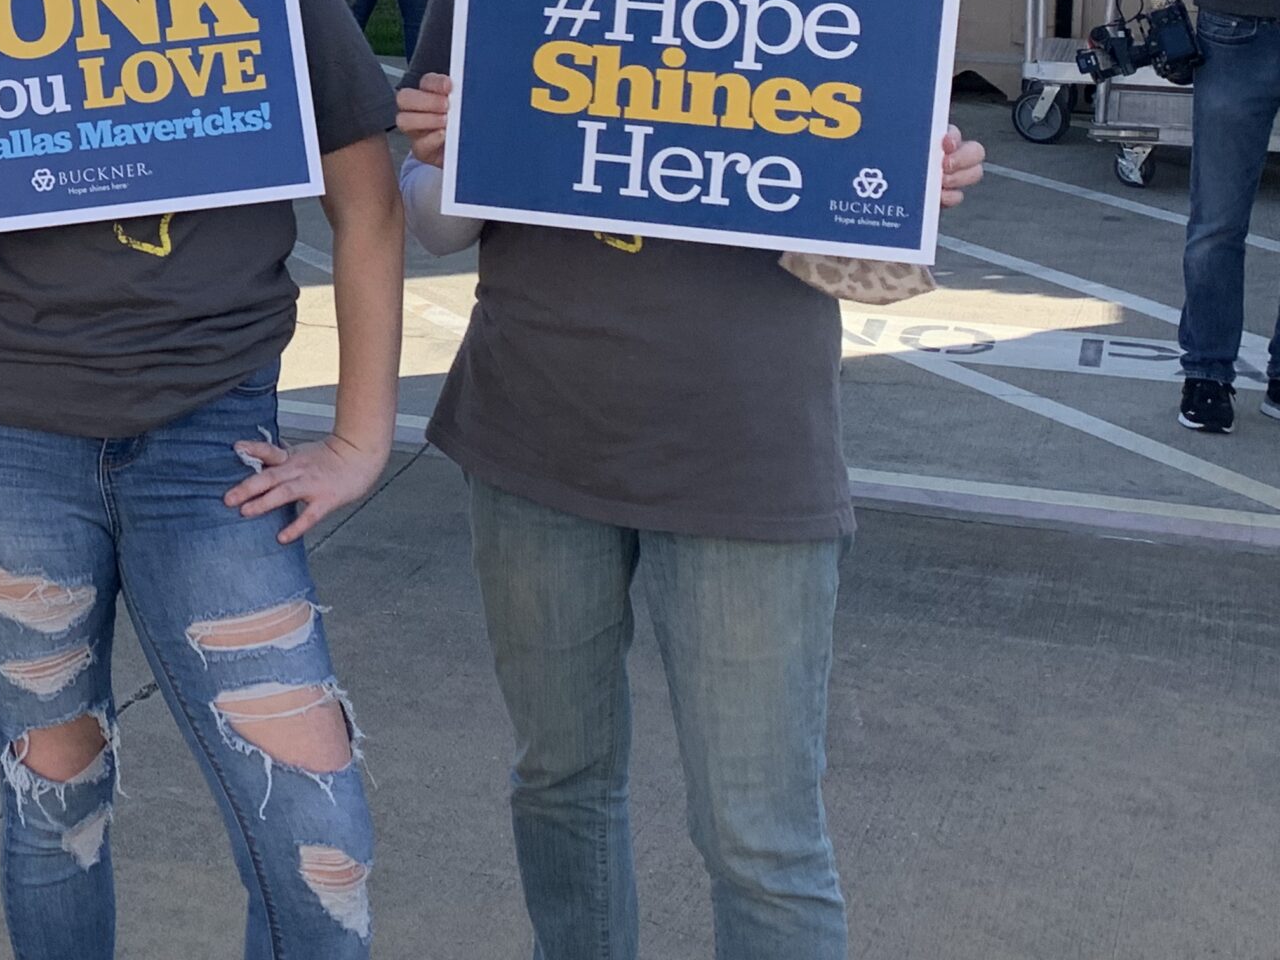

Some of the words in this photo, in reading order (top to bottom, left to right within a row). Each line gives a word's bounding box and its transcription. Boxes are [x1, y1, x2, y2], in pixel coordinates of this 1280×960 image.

[78, 40, 267, 110] LOVE
[530, 40, 862, 139] Shines
[77, 102, 272, 151] Mavericks!
[58, 162, 150, 186] BUCKNER
[572, 120, 803, 212] Here
